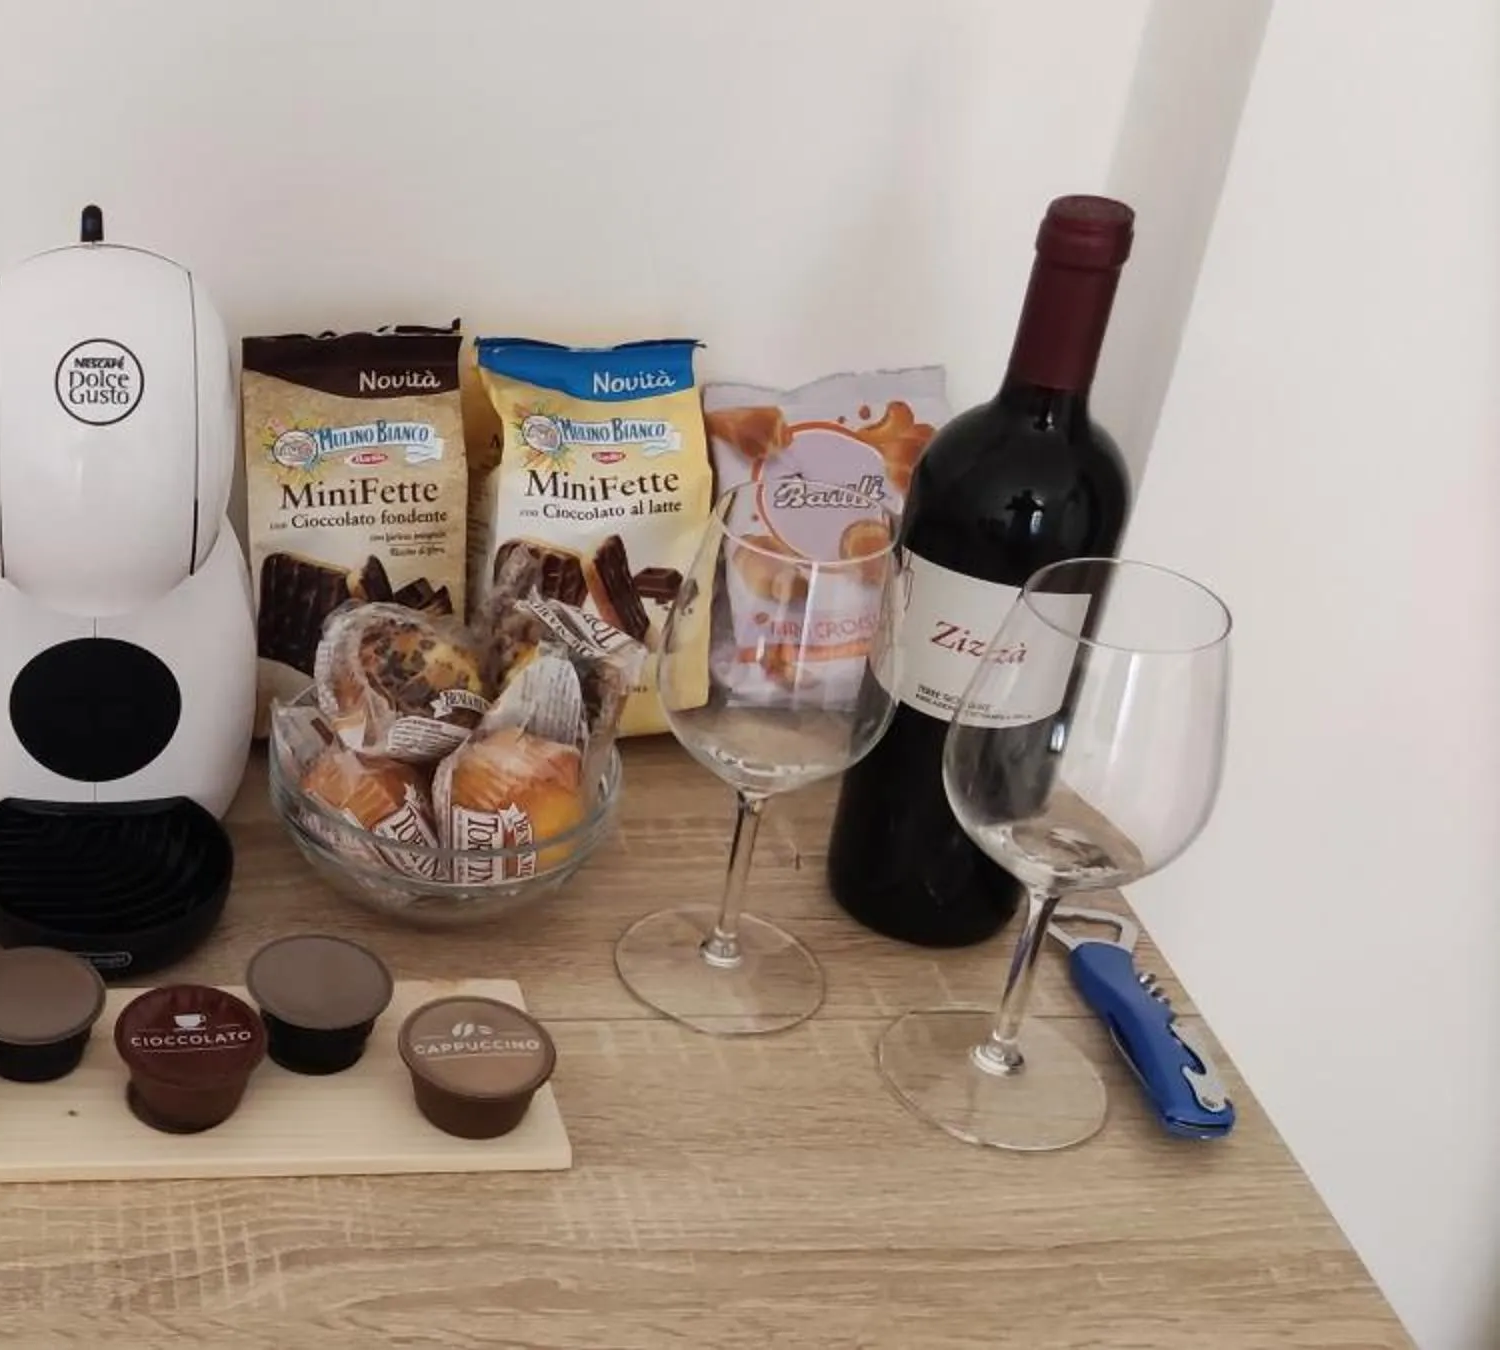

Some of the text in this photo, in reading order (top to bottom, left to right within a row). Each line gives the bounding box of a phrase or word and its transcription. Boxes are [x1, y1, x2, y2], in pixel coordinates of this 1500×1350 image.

[69, 370, 130, 389] Dolce
[358, 369, 442, 392] Novità
[593, 369, 677, 394] Novità
[69, 387, 130, 405] Gusto
[280, 477, 439, 510] MiniFette
[524, 469, 679, 502] MiniFette
[291, 510, 376, 529] Cioccolato
[381, 508, 448, 526] fondente
[543, 503, 625, 521] Cioccolato
[630, 501, 644, 516] al
[649, 499, 683, 514] latte
[130, 1030, 252, 1047] CIOCCOLATO
[413, 1039, 541, 1055] CAPPUCCINO
